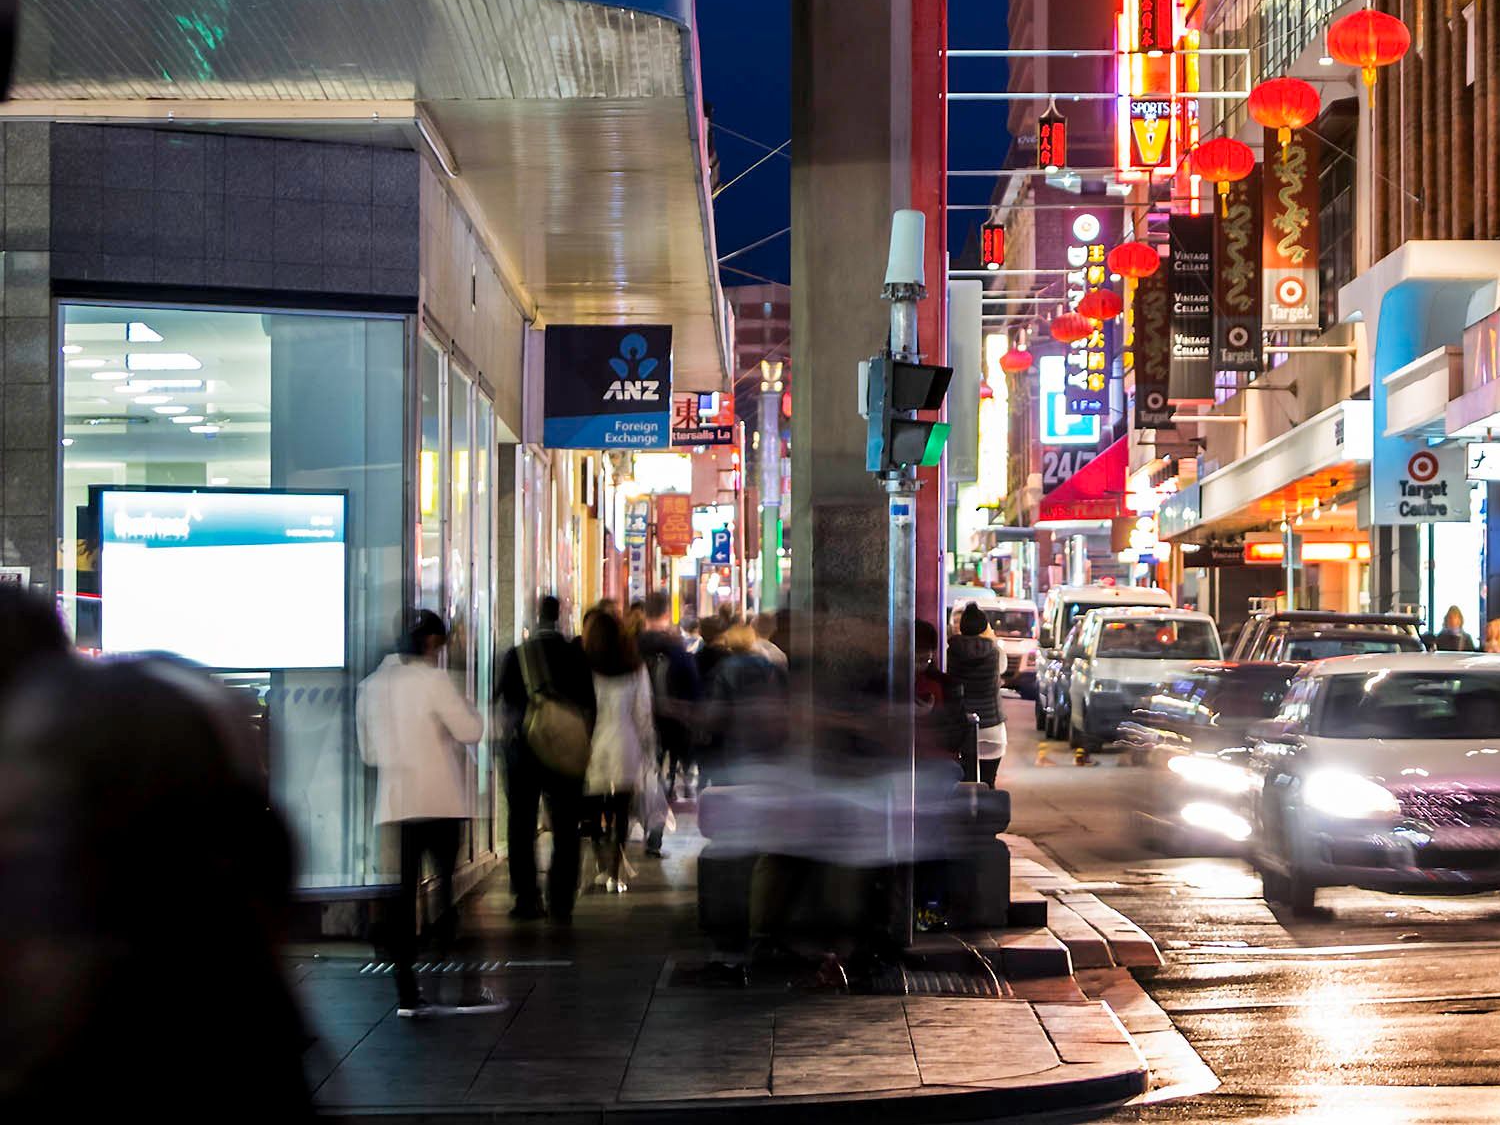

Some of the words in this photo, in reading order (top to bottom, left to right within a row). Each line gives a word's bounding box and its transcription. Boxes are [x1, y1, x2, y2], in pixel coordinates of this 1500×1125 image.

[1131, 101, 1170, 115] SPORTS
[603, 380, 660, 400] ANZ
[615, 420, 658, 433] Foreign
[605, 432, 658, 444] Exchange
[1399, 480, 1448, 499] Target
[1399, 500, 1448, 517] Centre
[715, 533, 727, 547] P
